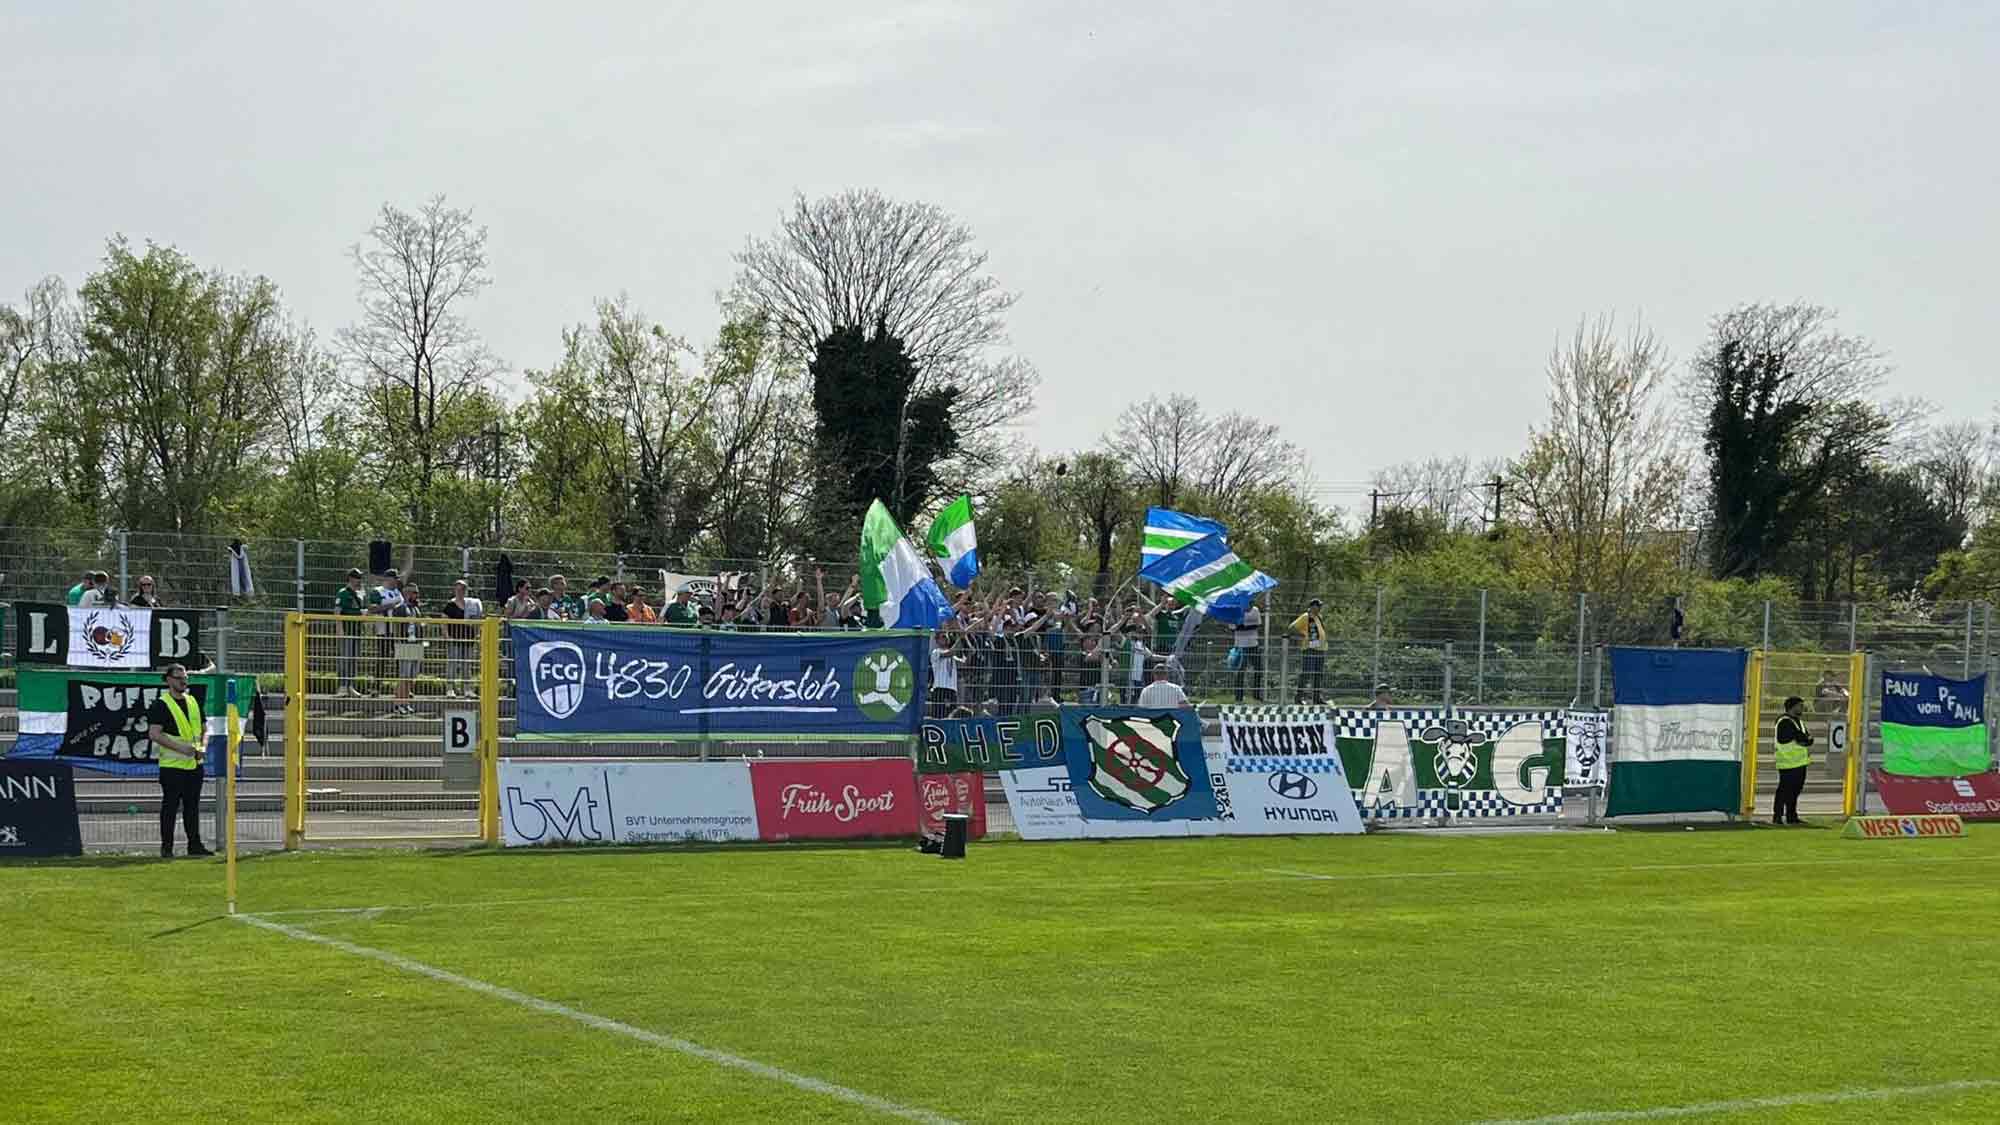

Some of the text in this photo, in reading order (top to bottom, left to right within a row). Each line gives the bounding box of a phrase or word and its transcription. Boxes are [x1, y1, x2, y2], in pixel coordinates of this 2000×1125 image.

[28, 612, 190, 658] L B
[540, 663, 578, 680] FCG
[595, 653, 840, 700] 4830 Gütersloh
[1885, 678, 1919, 697] FANS
[452, 717, 469, 748] B
[1226, 724, 1328, 756] MINDEN
[1833, 725, 1844, 748] C
[507, 787, 602, 840] bvt
[782, 784, 894, 821] Früh Sport
[1264, 806, 1338, 823] HYUNDAI
[1858, 817, 1961, 837] WEST LOTTO
